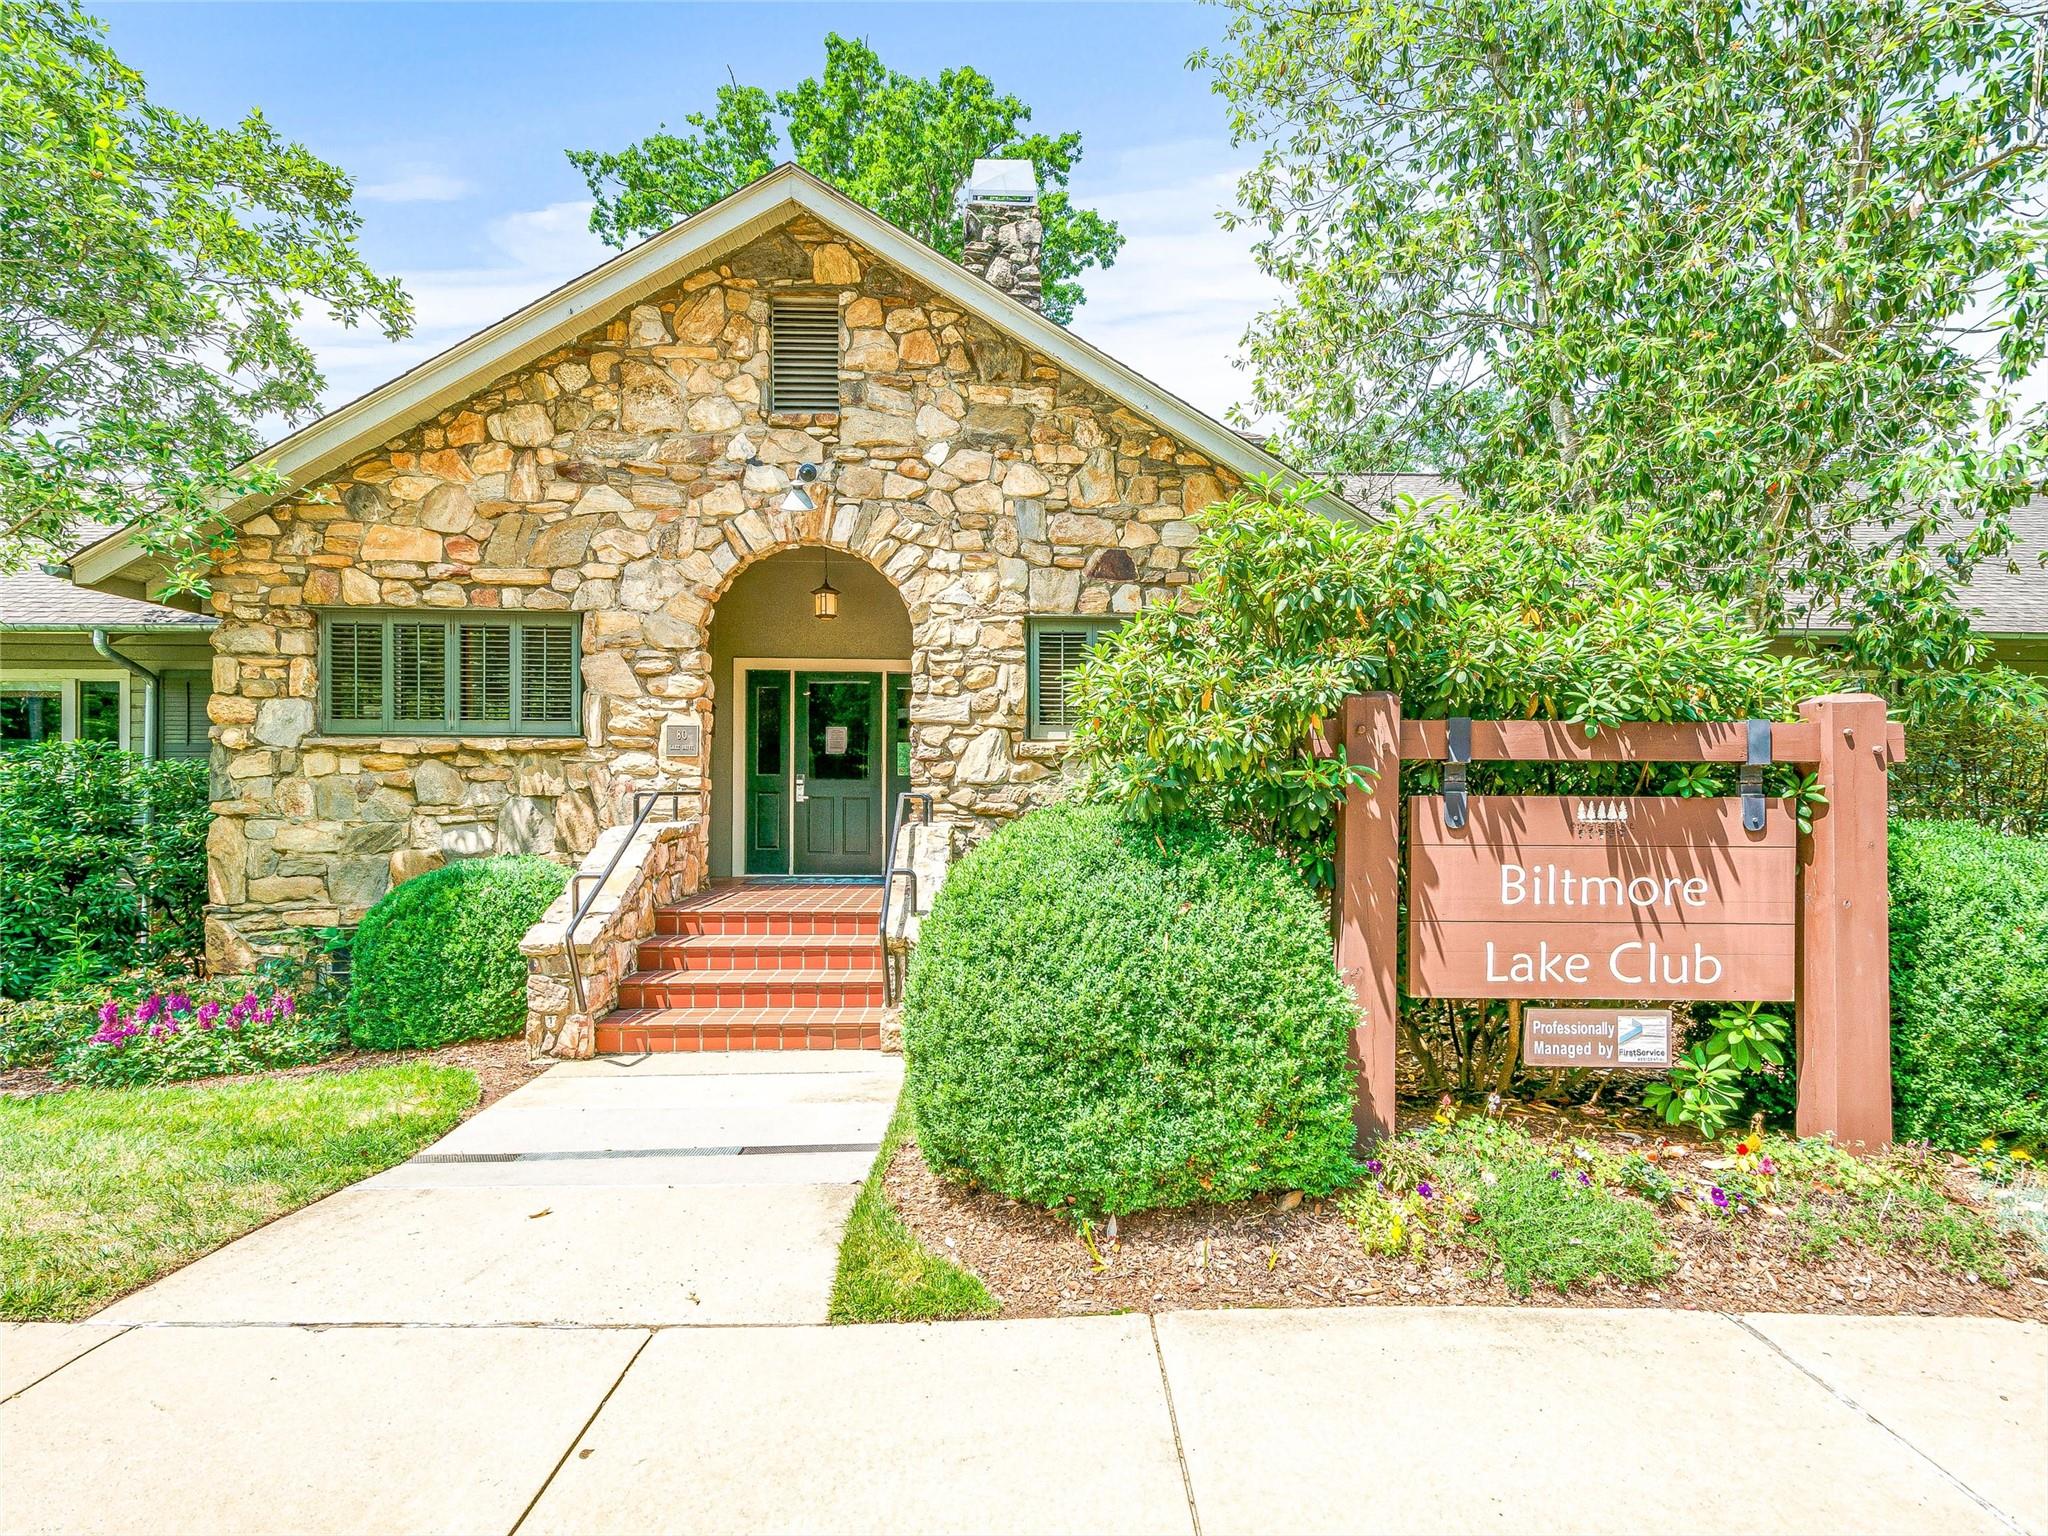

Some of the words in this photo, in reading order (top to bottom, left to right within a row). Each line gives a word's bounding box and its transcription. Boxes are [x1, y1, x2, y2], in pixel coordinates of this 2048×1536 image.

[676, 729, 688, 741] 80
[1501, 864, 1709, 906] Biltmore
[1486, 941, 1590, 983] Lake
[1609, 941, 1723, 984] Club
[1533, 1020, 1615, 1038] Professionally
[1534, 1040, 1592, 1058] Managed
[1598, 1041, 1613, 1059] by
[1619, 1048, 1665, 1057] FirstService
